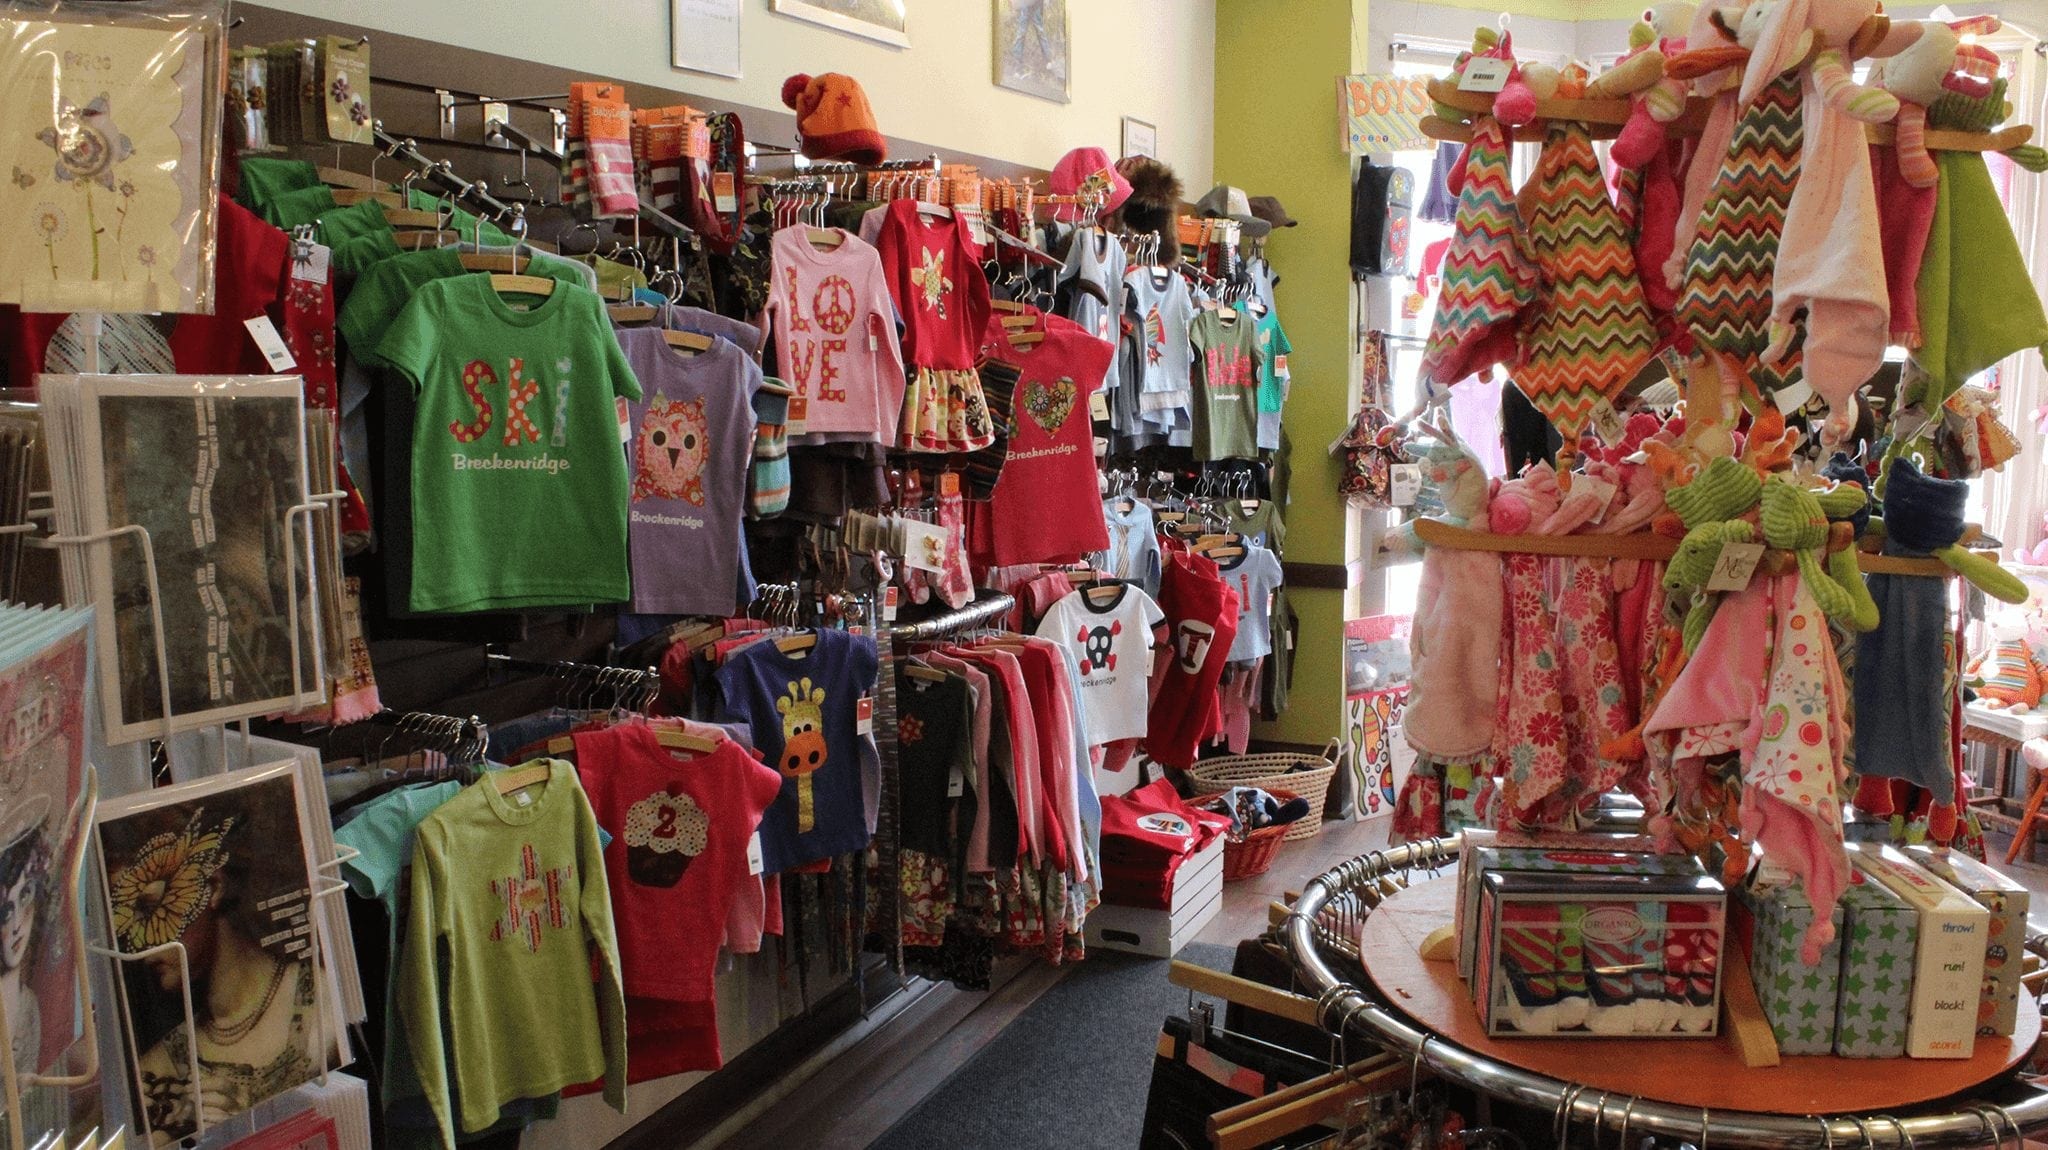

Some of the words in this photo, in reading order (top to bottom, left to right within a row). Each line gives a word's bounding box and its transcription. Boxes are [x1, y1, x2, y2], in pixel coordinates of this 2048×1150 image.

[1349, 80, 1427, 117] BOYS
[448, 356, 572, 447] Ski
[1005, 443, 1079, 461] Breckenridge
[451, 452, 570, 475] Breckenridge
[631, 510, 705, 530] Breckenridge
[652, 803, 677, 839] 2
[1942, 923, 1975, 933] throw!
[1943, 962, 1965, 972] run!
[1934, 1000, 1965, 1011] block!
